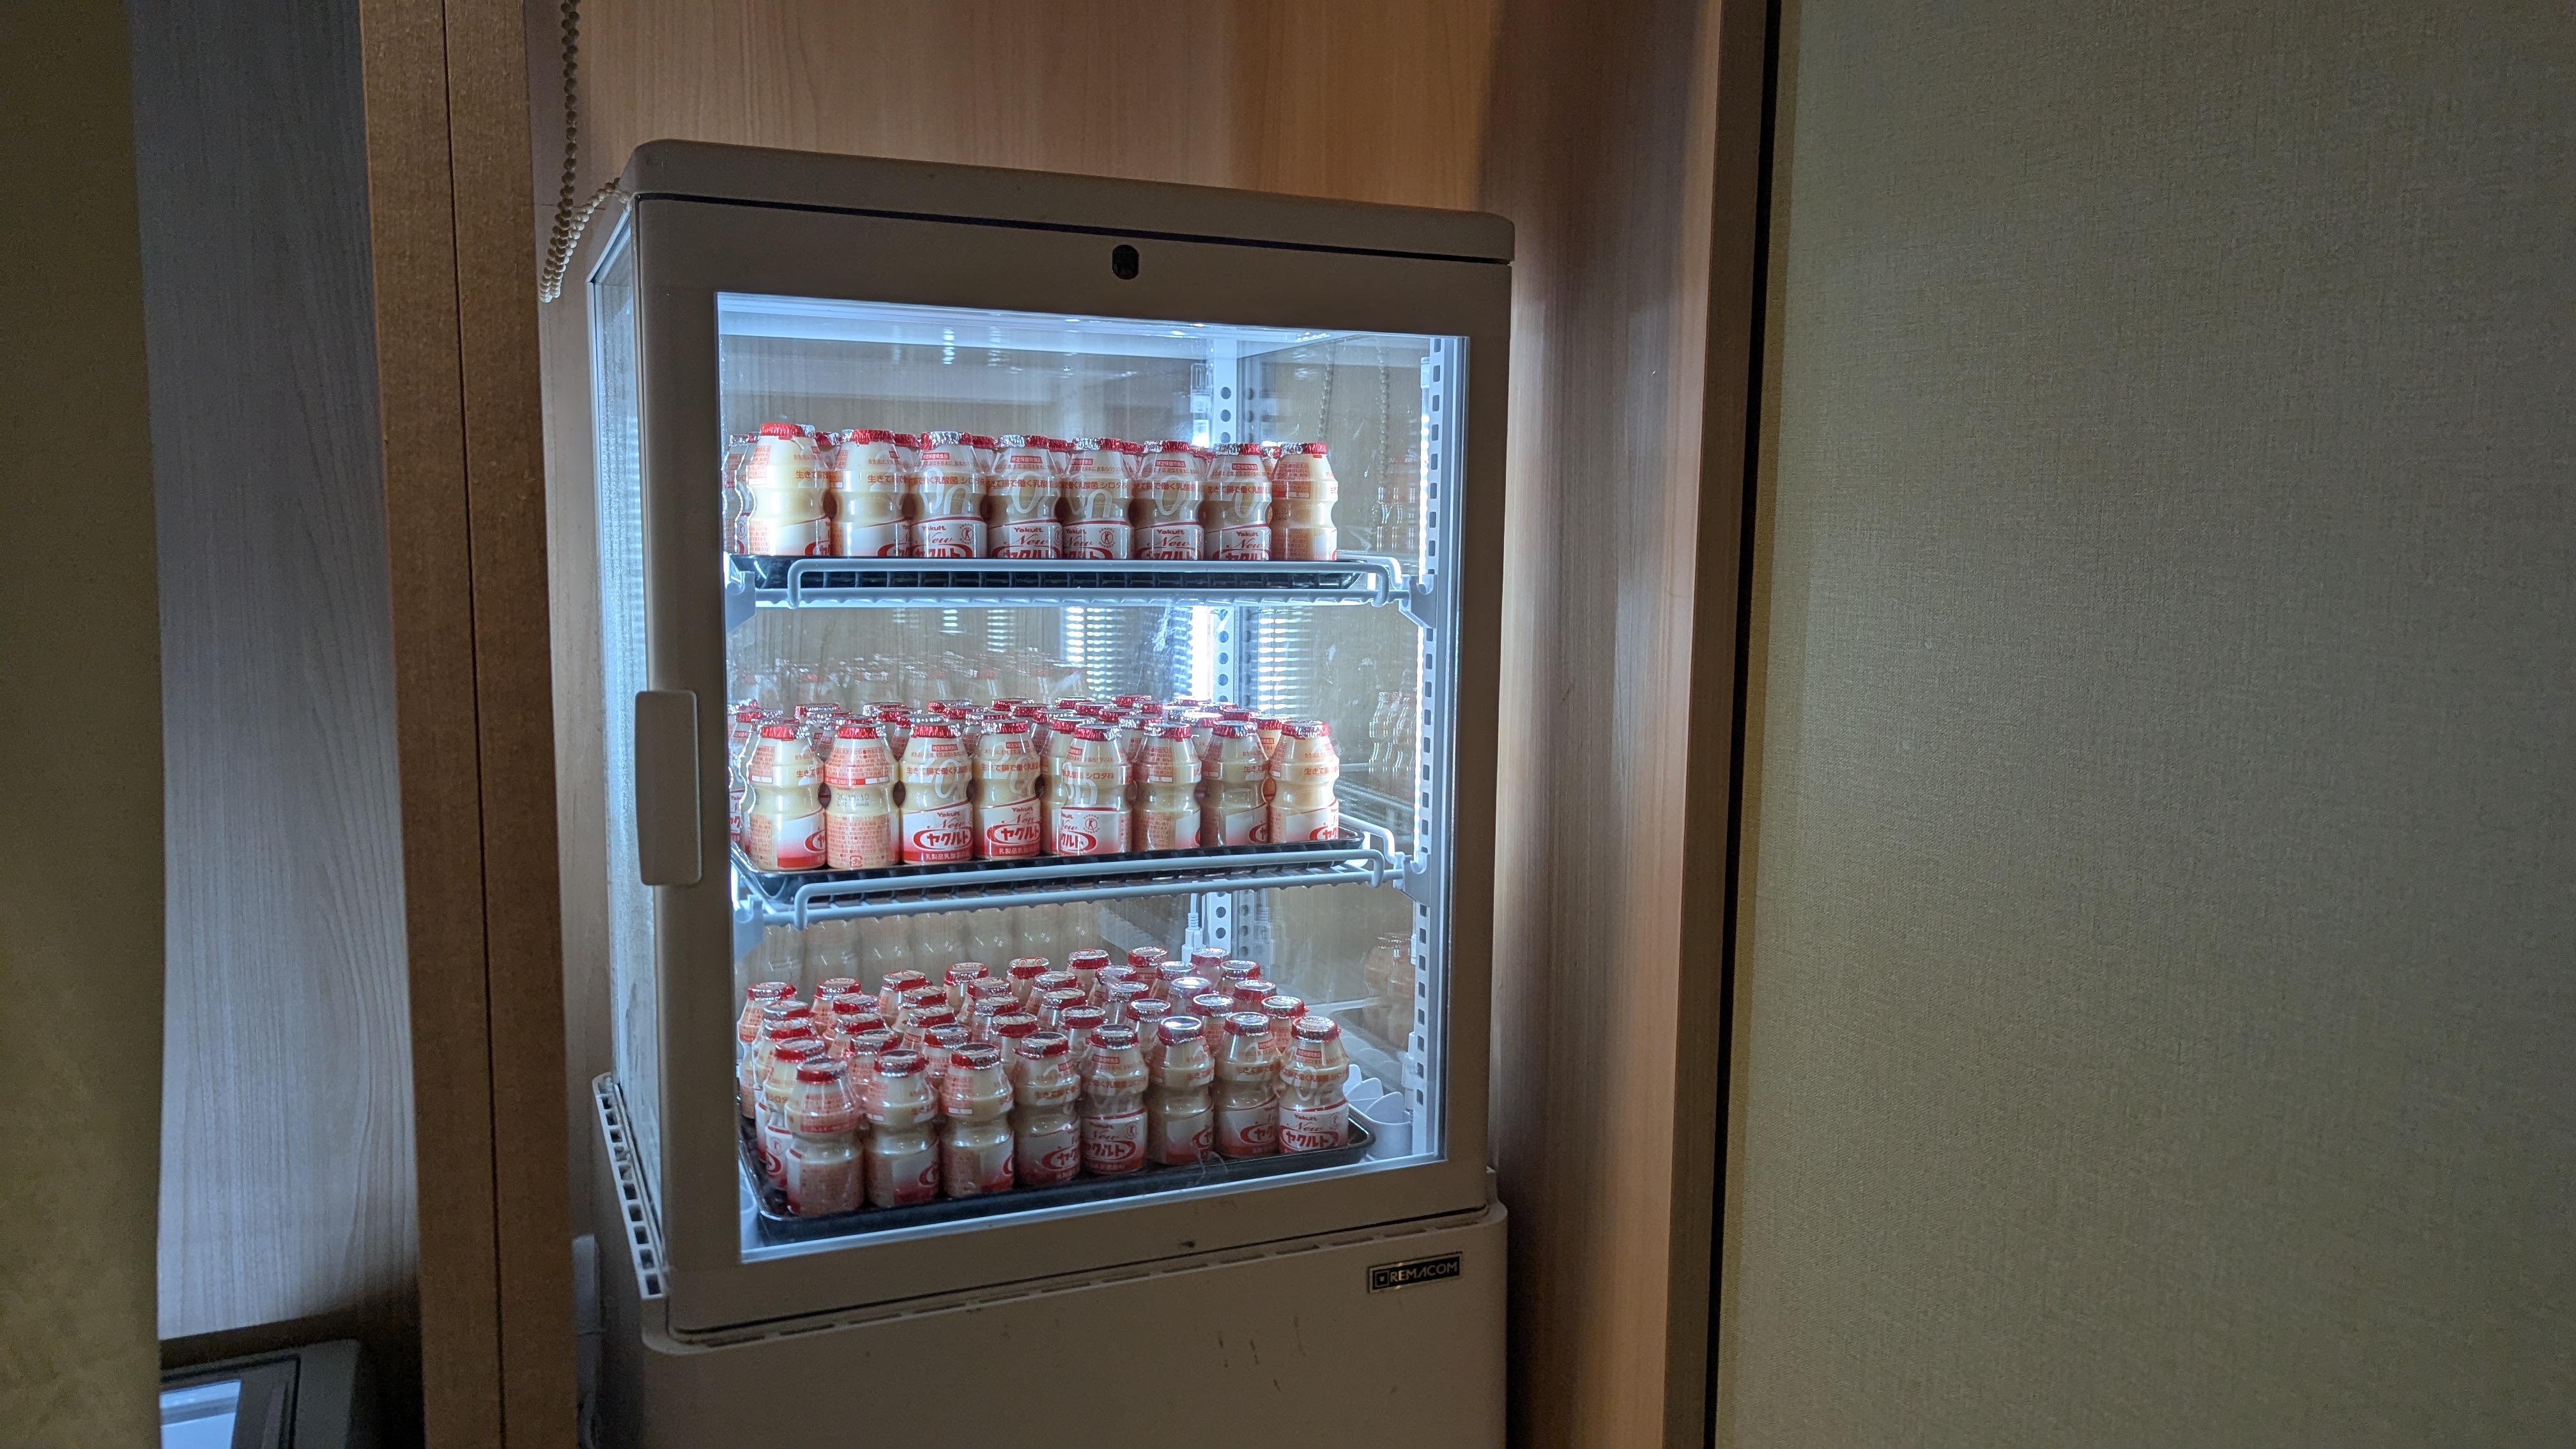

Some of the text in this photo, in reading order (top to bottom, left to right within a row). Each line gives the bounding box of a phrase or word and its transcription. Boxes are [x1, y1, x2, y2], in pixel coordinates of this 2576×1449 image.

[1086, 772, 1115, 780] シロタ株
[926, 830, 969, 847] ヤクルト
[1000, 825, 1039, 841] ヤクルト
[1285, 1131, 1329, 1148] ヤクルト
[1390, 1261, 1457, 1282] REMACOM
